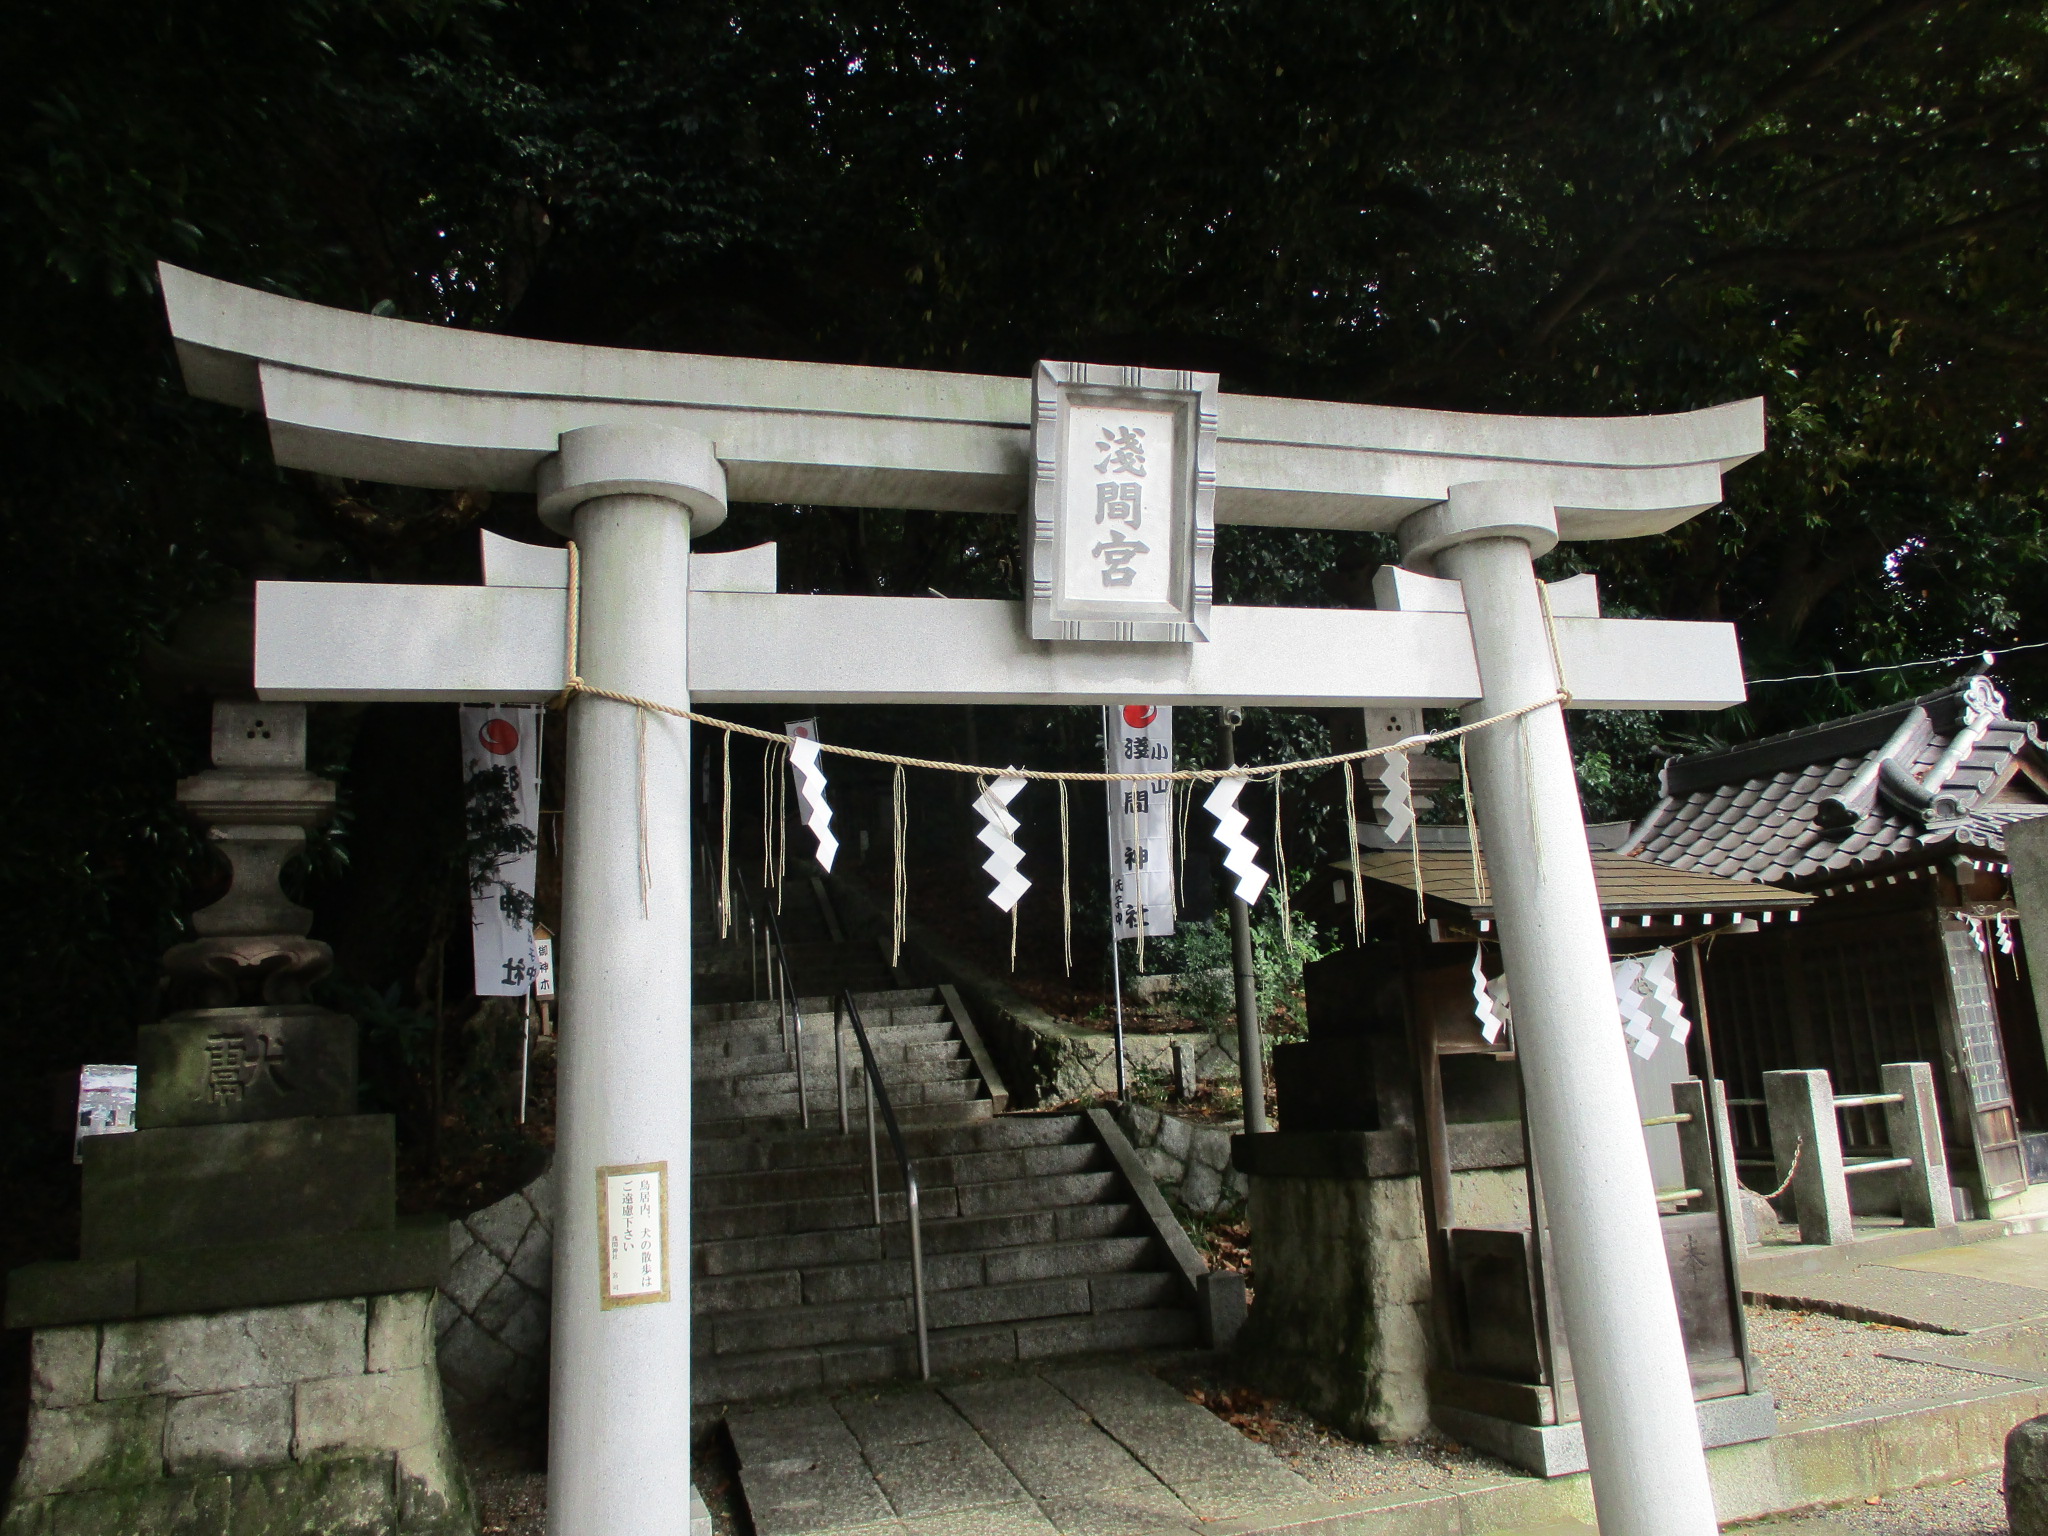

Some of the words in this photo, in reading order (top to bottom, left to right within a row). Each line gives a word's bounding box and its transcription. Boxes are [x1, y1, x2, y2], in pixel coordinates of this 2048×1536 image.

[1091, 425, 1150, 588] 淺間宮
[1150, 743, 1169, 794] 小山
[1114, 879, 1124, 925] 氏子中
[621, 1180, 635, 1252] ご遠慮下さい
